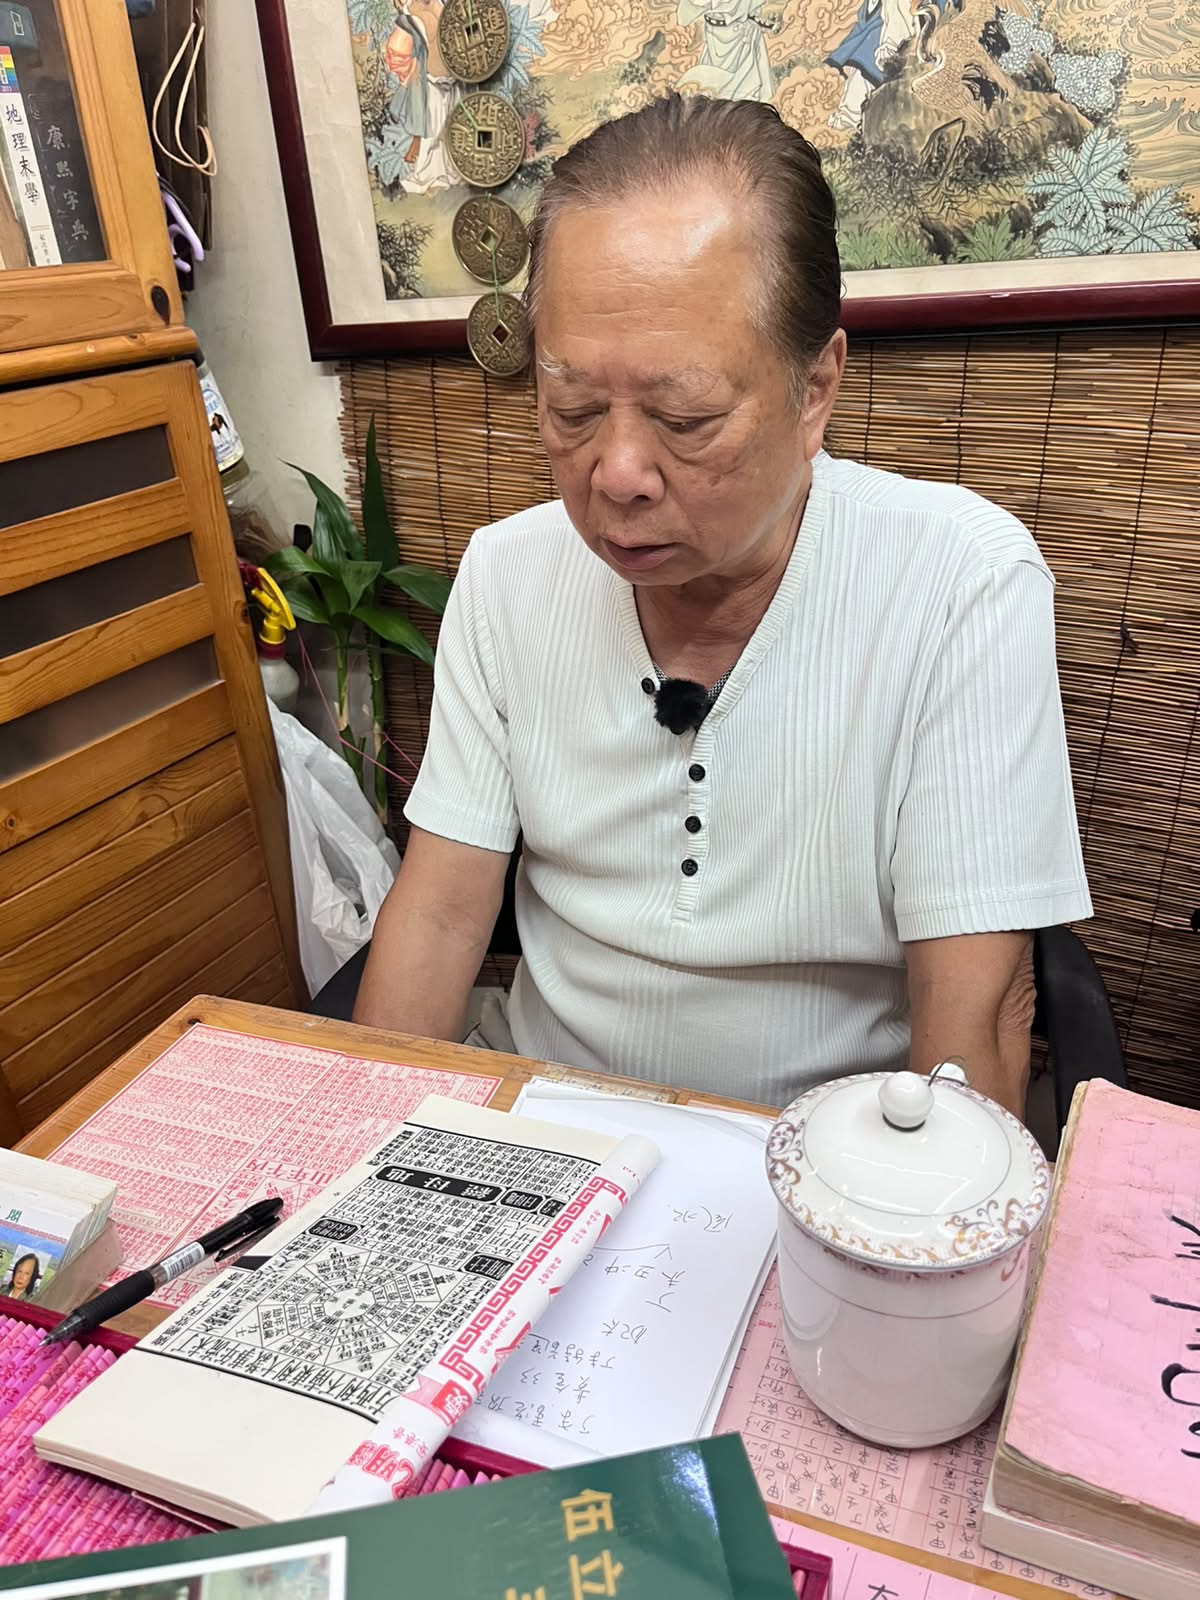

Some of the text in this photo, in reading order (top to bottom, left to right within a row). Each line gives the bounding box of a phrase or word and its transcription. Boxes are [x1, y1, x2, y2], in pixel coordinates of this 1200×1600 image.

[5, 103, 41, 206] 地理末學
[47, 124, 89, 241] 康熙字典
